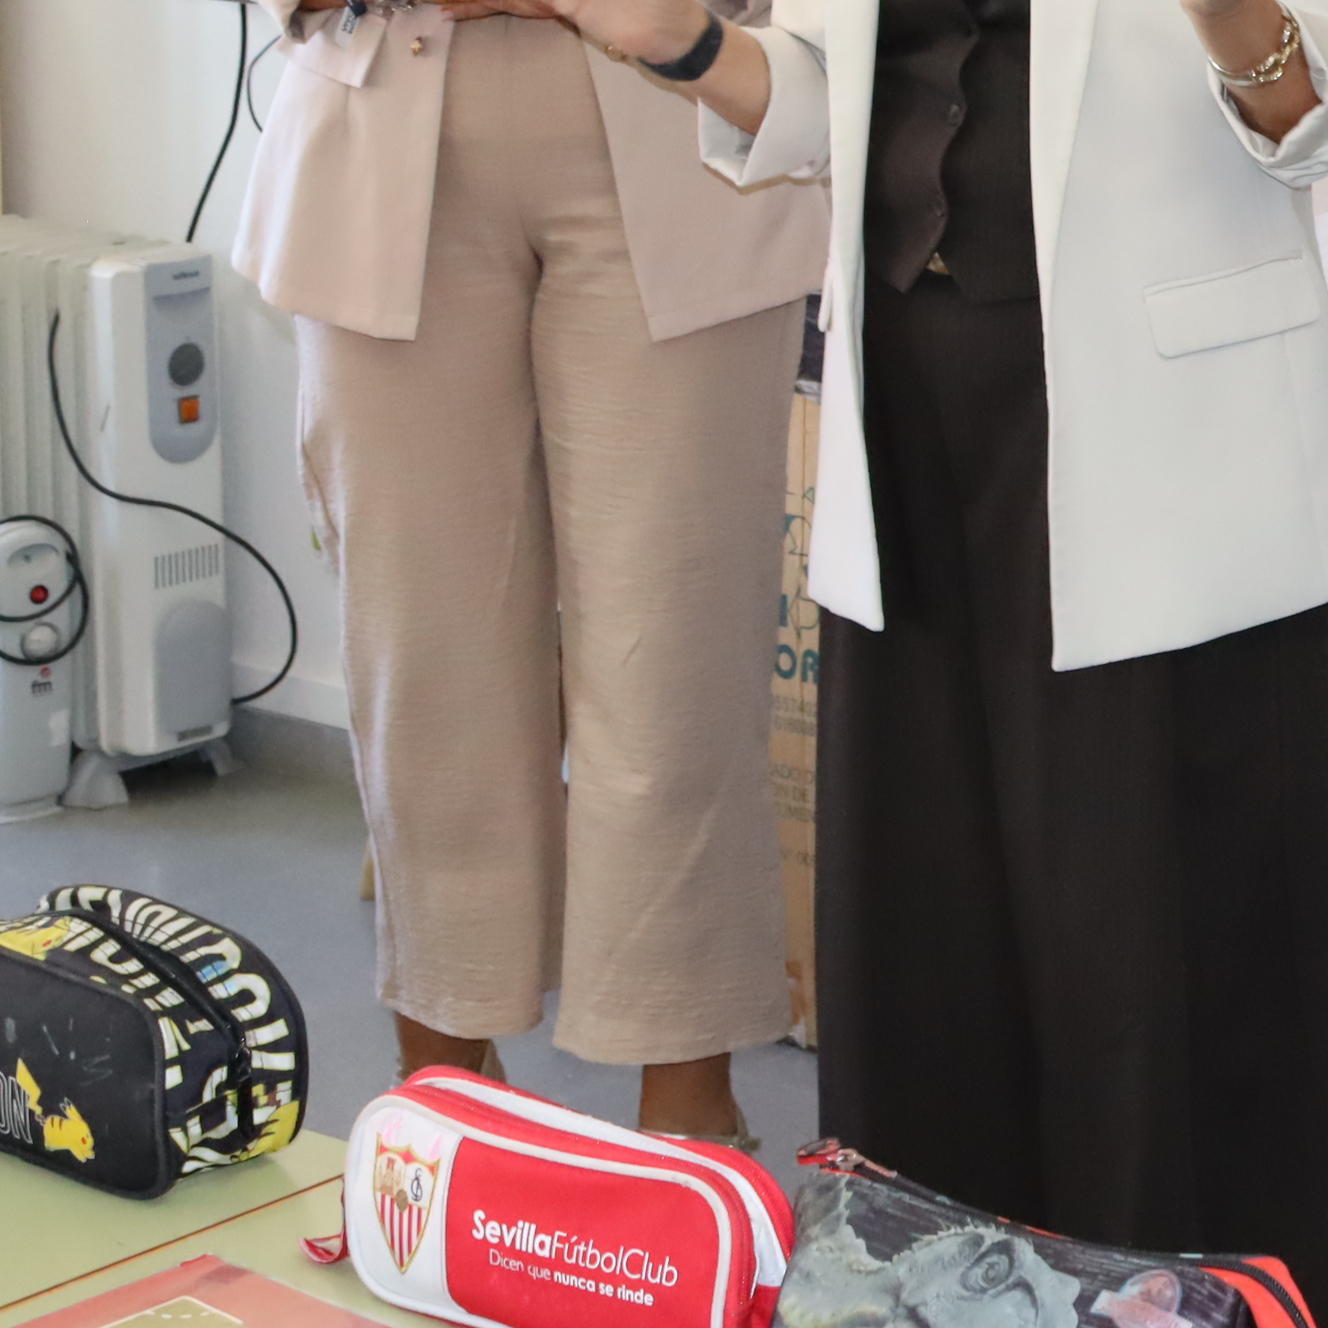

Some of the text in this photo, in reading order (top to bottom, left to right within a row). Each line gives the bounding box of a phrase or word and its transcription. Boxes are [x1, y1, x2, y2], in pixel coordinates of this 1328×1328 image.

[472, 1209, 679, 1287] SevillaFútbolClub
[489, 1248, 654, 1307] Dicen que nunca se rinde
